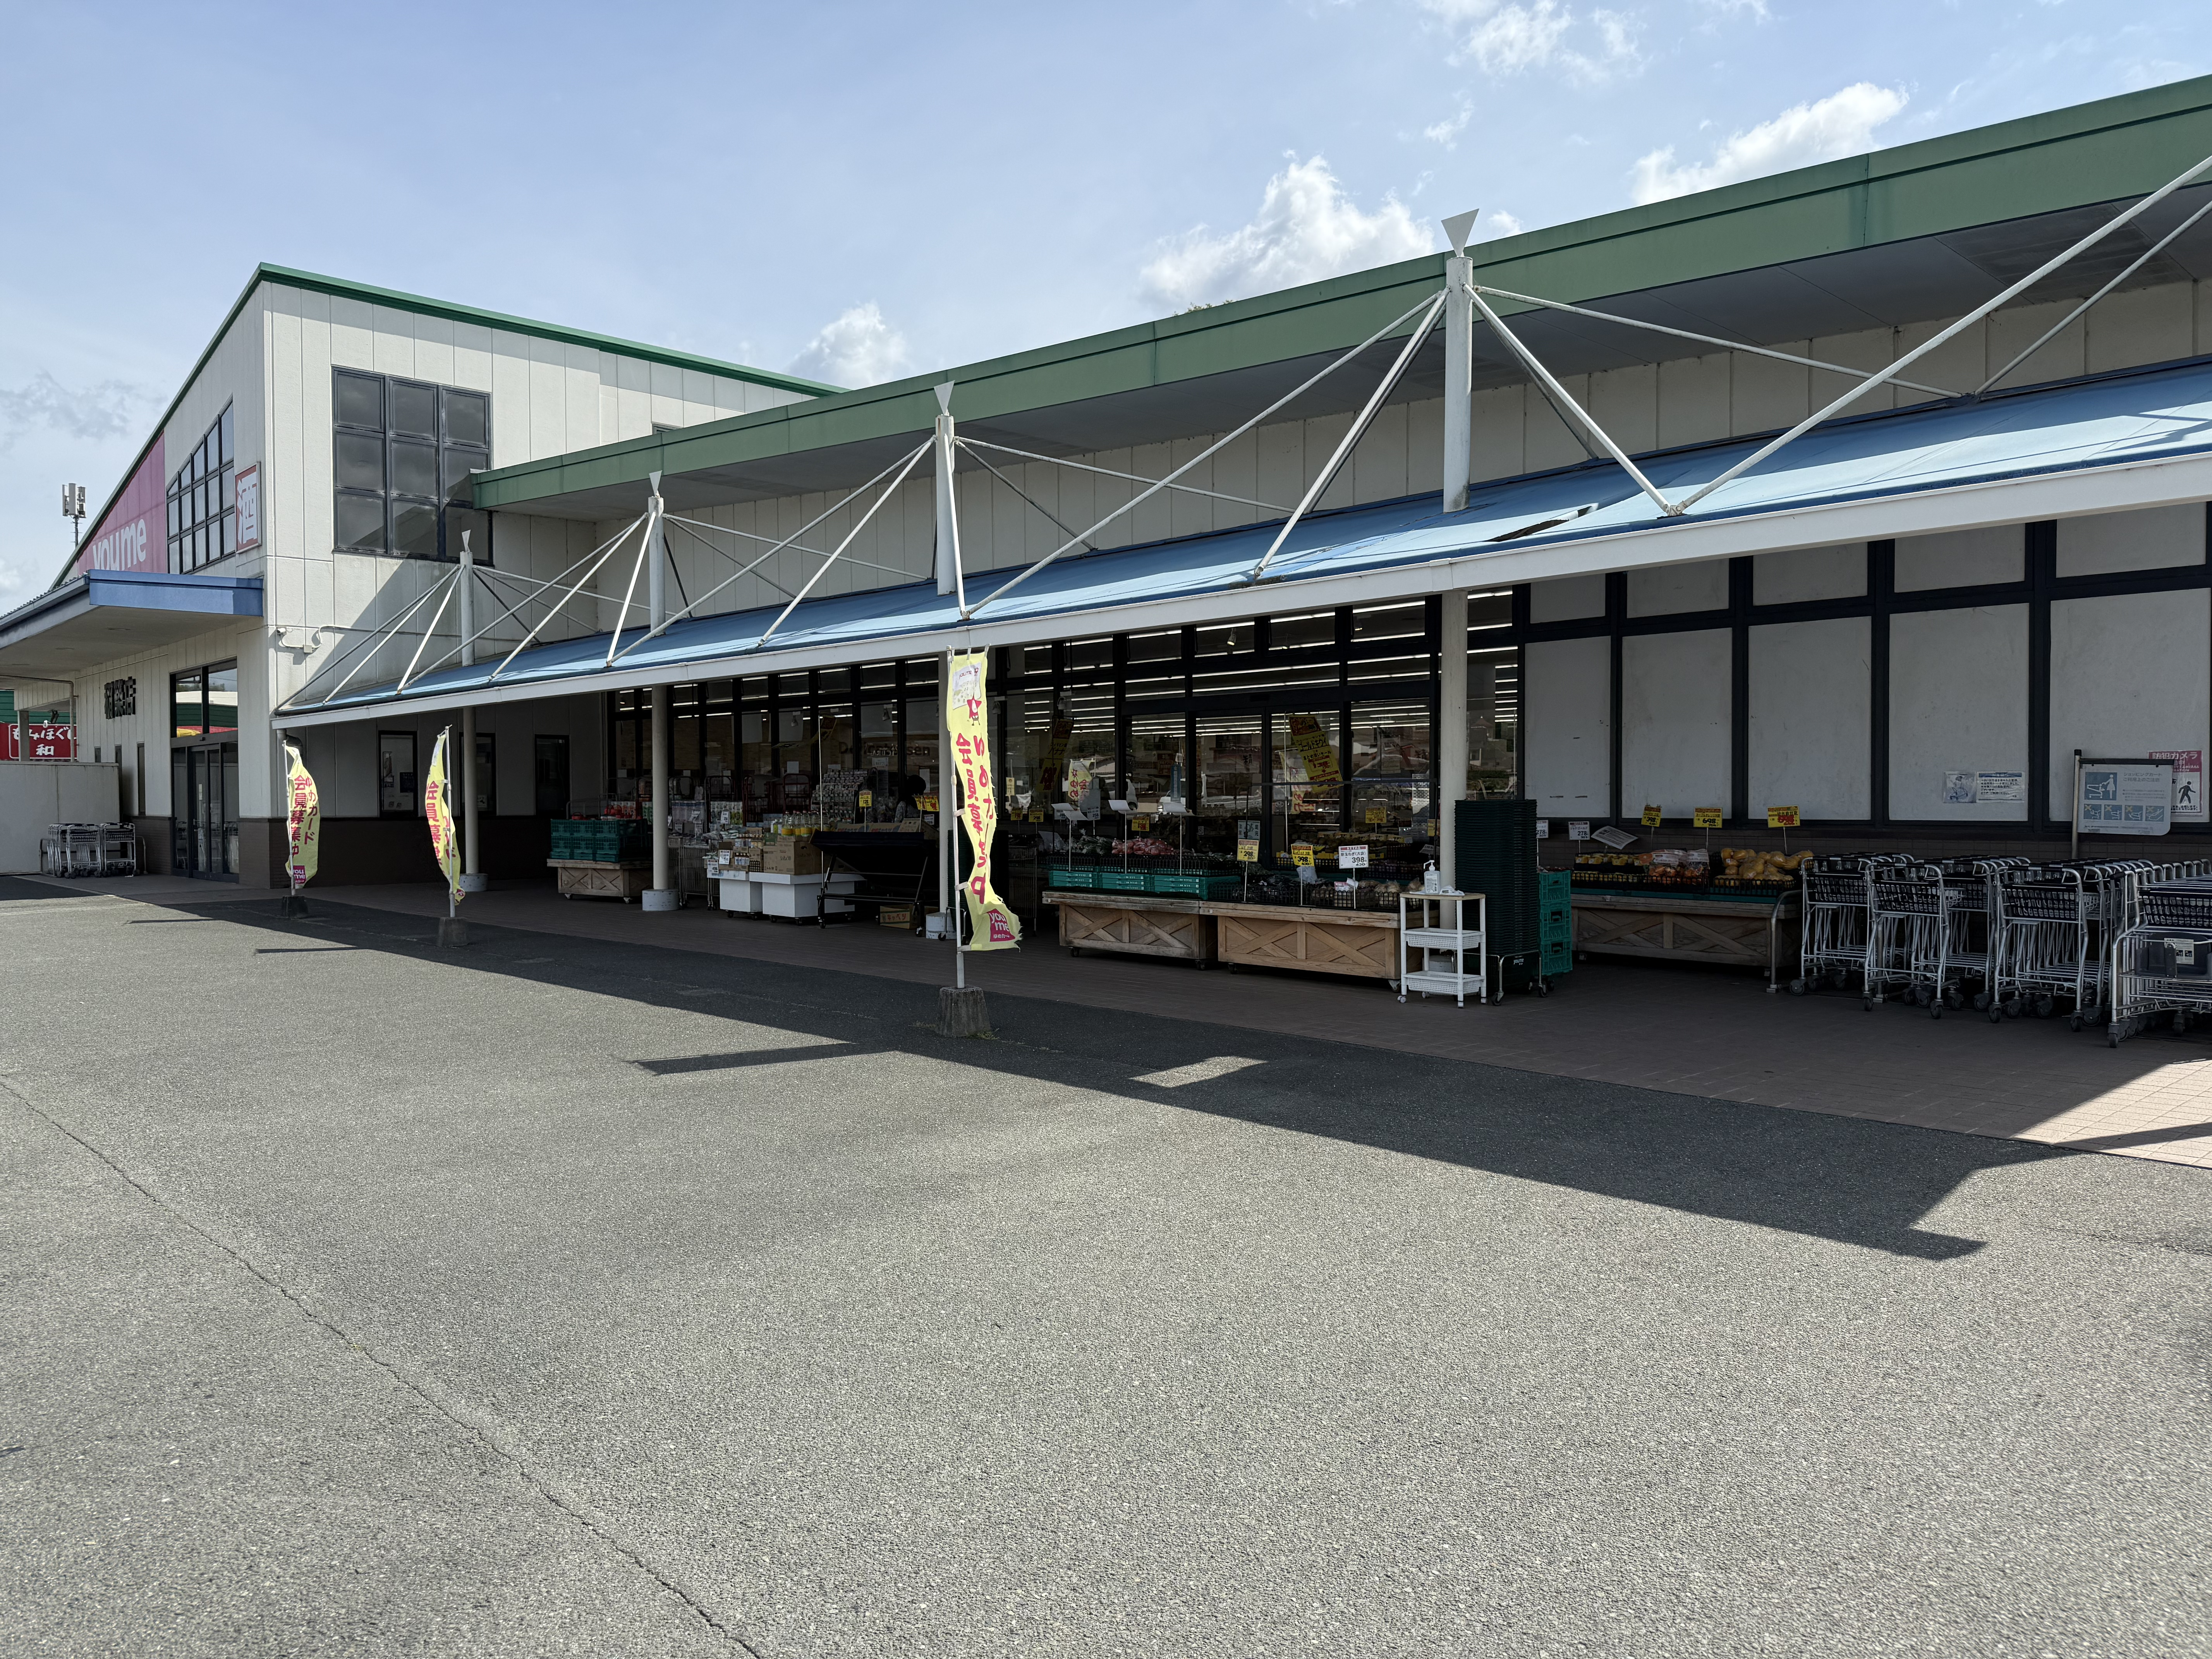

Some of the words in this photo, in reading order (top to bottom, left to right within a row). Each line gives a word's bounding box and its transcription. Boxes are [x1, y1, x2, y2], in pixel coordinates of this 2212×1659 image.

[237, 471, 258, 544] 酒
[93, 519, 146, 570] youme
[36, 744, 54, 756] 和
[988, 913, 1006, 924] you
[994, 922, 1010, 932] me
